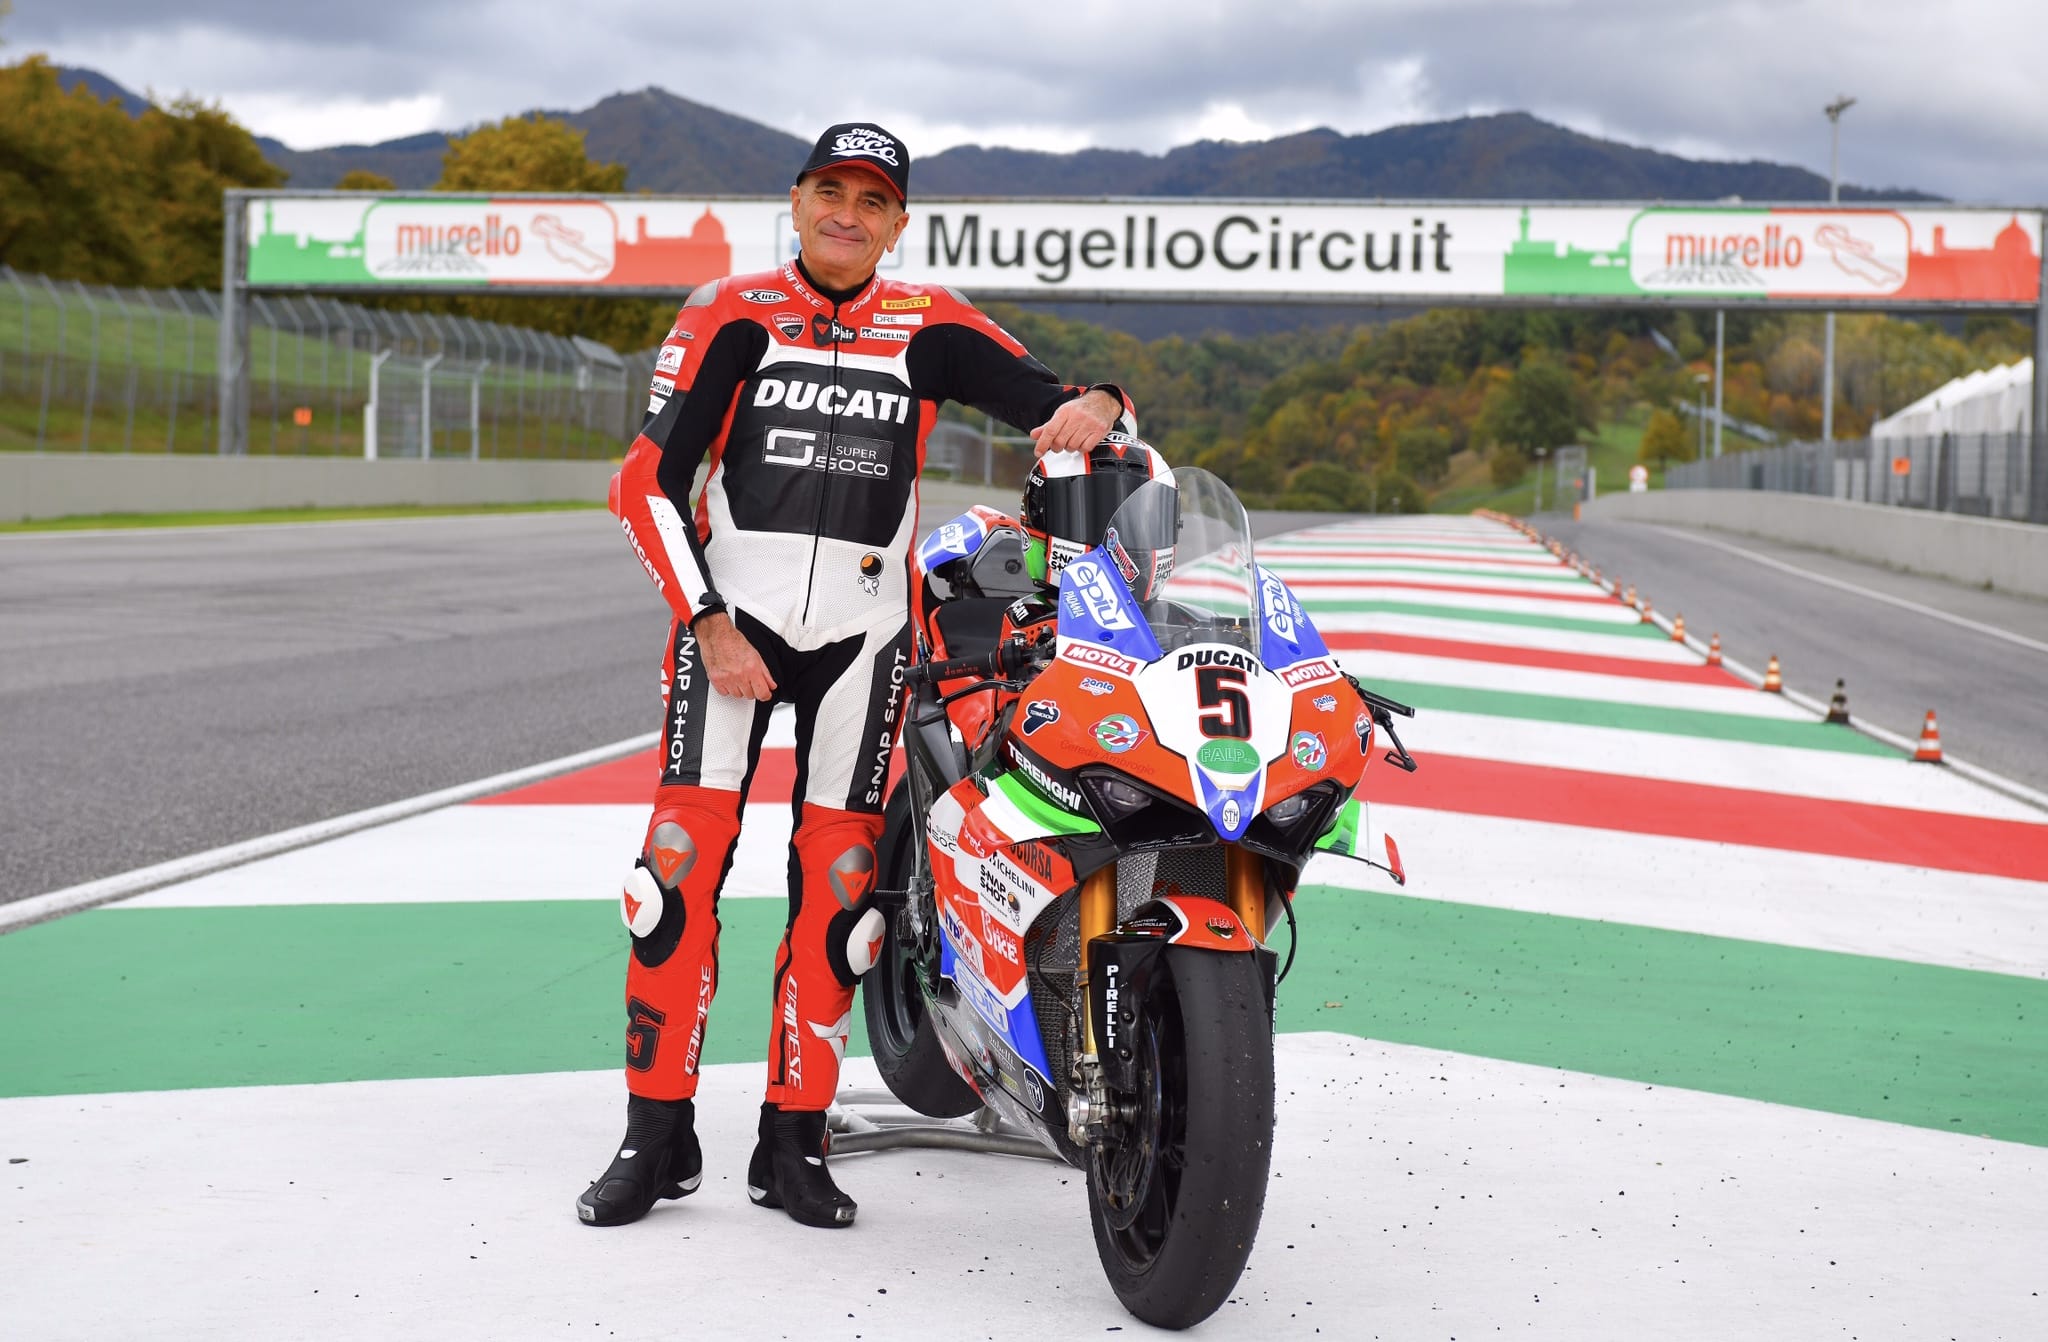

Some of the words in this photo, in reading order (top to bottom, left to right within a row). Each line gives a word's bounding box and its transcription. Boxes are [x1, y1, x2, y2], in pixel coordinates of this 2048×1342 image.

[396, 213, 521, 257] mugello
[926, 213, 1453, 283] MugelloCircuit
[1665, 223, 1802, 270] mugello
[776, 315, 802, 323] DUCATI
[885, 297, 929, 309] PIRELLI
[860, 328, 909, 341] MICHELINI
[753, 379, 910, 424] DUCATI
[836, 446, 877, 460] SUPER
[620, 516, 666, 594] DUCATI
[1067, 646, 1130, 673] MOTUL
[1177, 650, 1259, 677] DUCATI
[1287, 663, 1332, 684] MOTUL
[1195, 665, 1252, 742] 5
[1007, 740, 1082, 811] TERENGHI
[989, 851, 1035, 898] MICHELINI
[685, 963, 711, 1077] DAINESE
[1106, 965, 1119, 1049] PIRELLI
[625, 995, 667, 1073] 5
